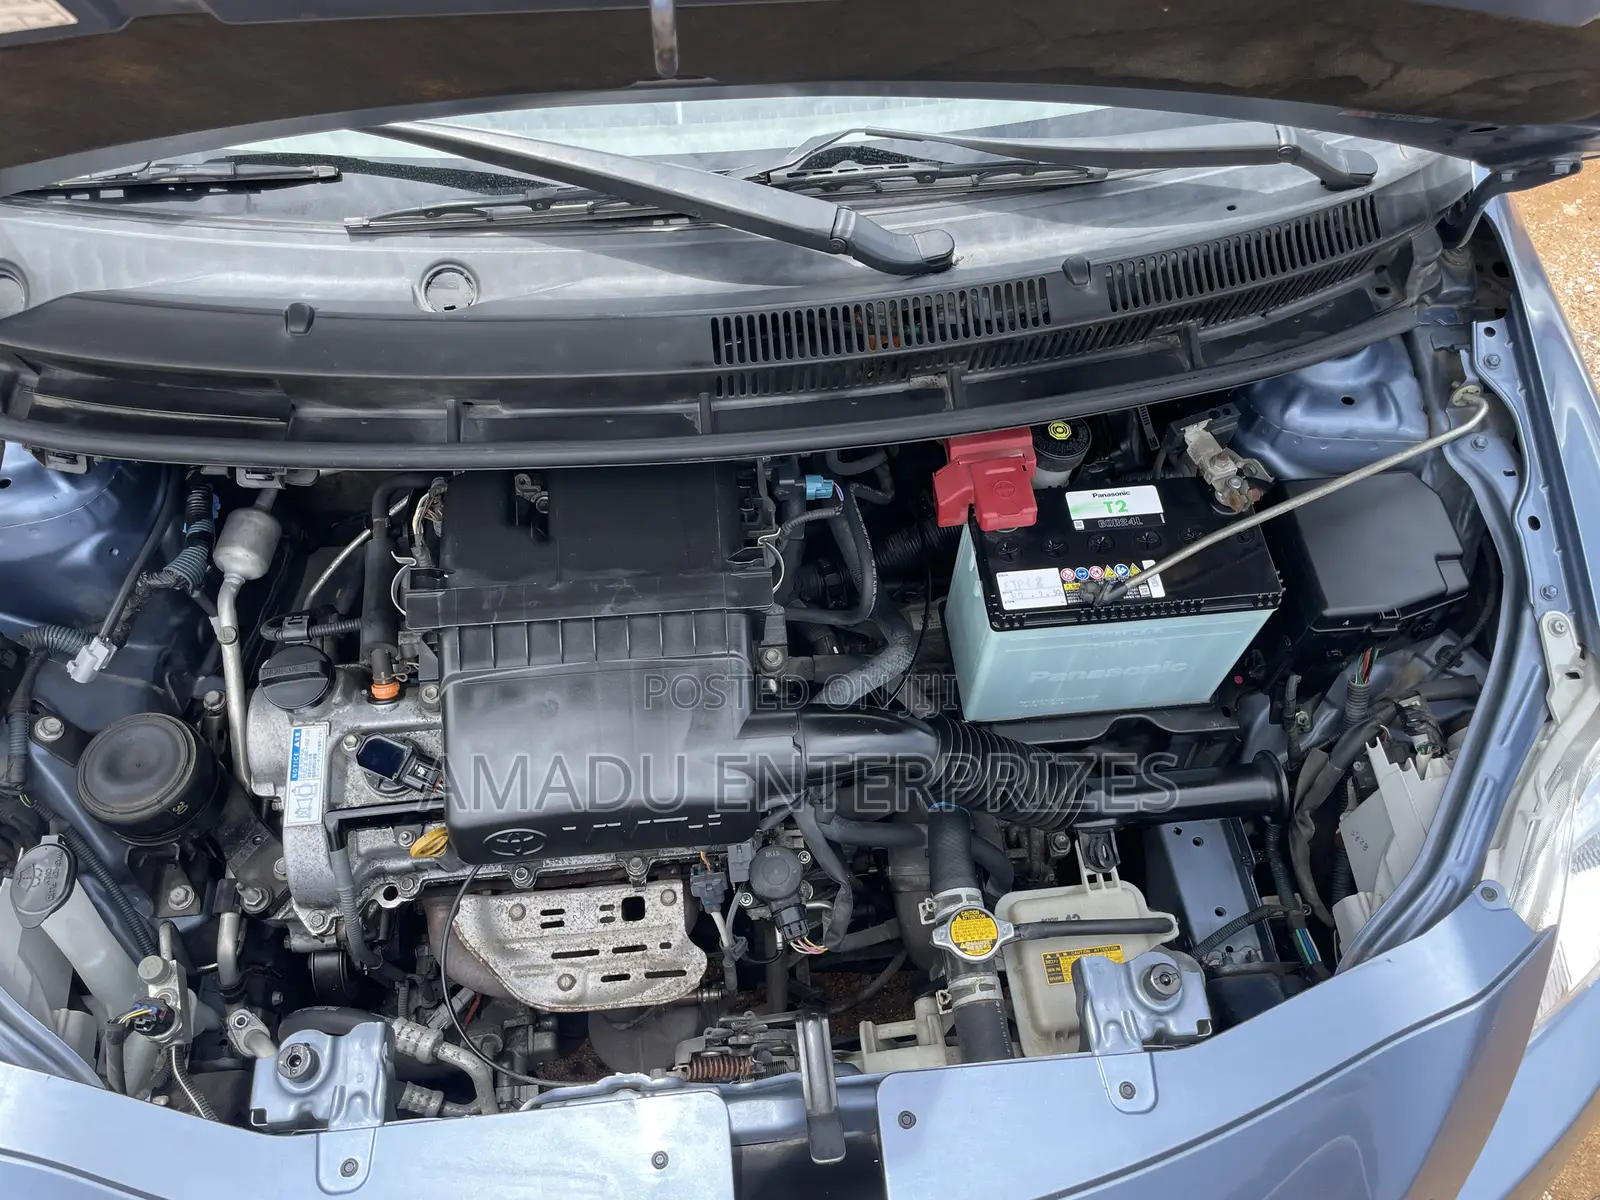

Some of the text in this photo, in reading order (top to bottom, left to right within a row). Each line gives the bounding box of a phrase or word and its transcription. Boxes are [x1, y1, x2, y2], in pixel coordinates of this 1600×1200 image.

[1092, 490, 1131, 499] Panasonic
[1102, 500, 1129, 513] T2
[1029, 661, 1188, 684] Panasonic
[291, 752, 300, 779] NOTICE
